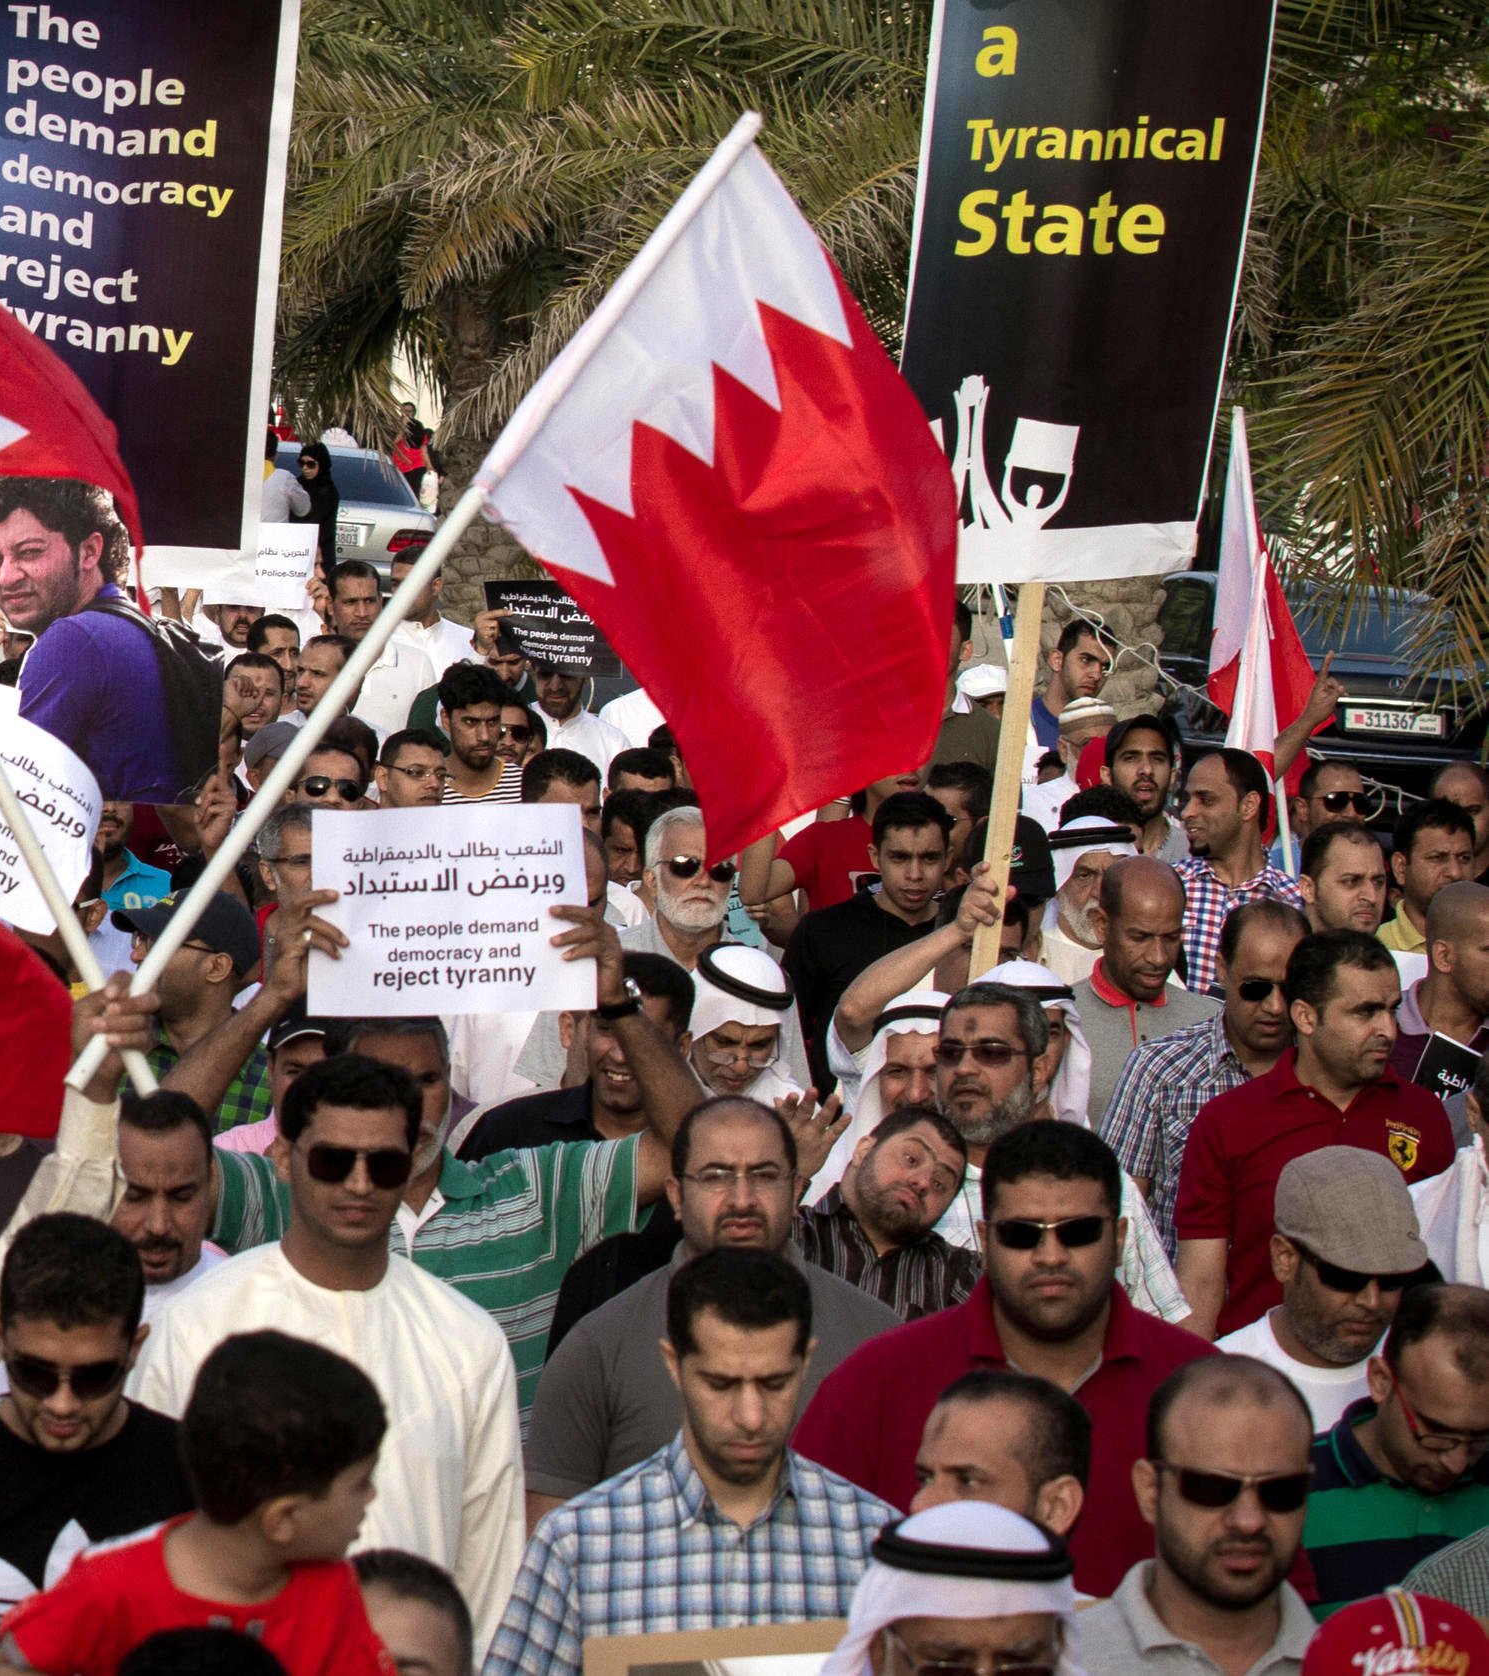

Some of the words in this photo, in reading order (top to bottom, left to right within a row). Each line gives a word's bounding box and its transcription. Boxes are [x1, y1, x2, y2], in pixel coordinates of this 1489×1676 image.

[8, 4, 100, 50] The
[975, 25, 1019, 78] a
[7, 58, 186, 115] people
[4, 99, 217, 158] demand
[966, 115, 1227, 173] Tyrannical
[1, 153, 234, 218] democracy
[954, 189, 1166, 257] State
[513, 626, 529, 637] The
[530, 630, 558, 641] people
[559, 632, 595, 643] demand
[568, 644, 586, 653] and
[548, 650, 593, 667] tyranny
[1365, 712, 1417, 731] 311367
[0, 747, 46, 783] يطالب
[15, 783, 87, 840] ويرفض
[342, 844, 443, 867] بالديمقراطية
[446, 841, 500, 861] يطالب
[505, 838, 564, 857] الشعب
[343, 867, 459, 900] الاستبداد
[467, 867, 566, 897] ويرفض
[368, 923, 401, 939] The
[405, 920, 463, 940] people
[468, 918, 540, 936] demand
[387, 946, 482, 966] democracy
[488, 943, 521, 959] and
[373, 967, 440, 992] reject
[446, 965, 537, 990] tyranny
